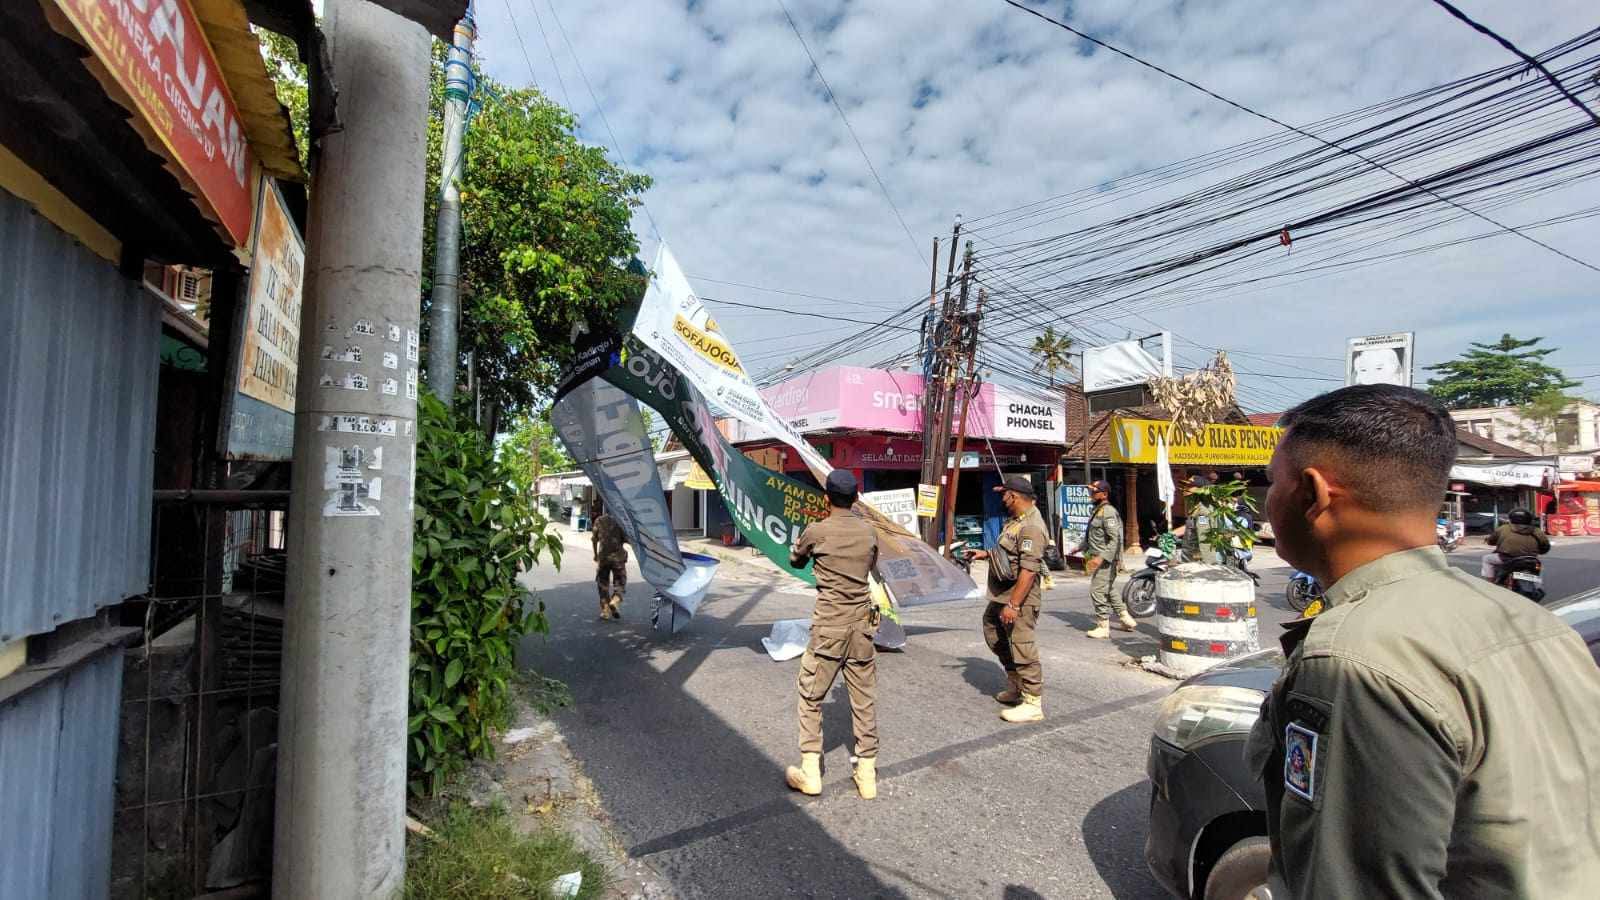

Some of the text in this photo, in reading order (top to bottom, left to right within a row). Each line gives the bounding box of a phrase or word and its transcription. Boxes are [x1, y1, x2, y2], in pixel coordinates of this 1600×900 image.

[1009, 403, 1053, 417] CHACHA
[1007, 416, 1055, 431] PHONSEL
[1208, 427, 1238, 449] RIAS
[862, 453, 901, 463] SELAMAT
[766, 476, 805, 499] AYAM
[1066, 486, 1090, 497] BISA
[783, 507, 801, 523] RP
